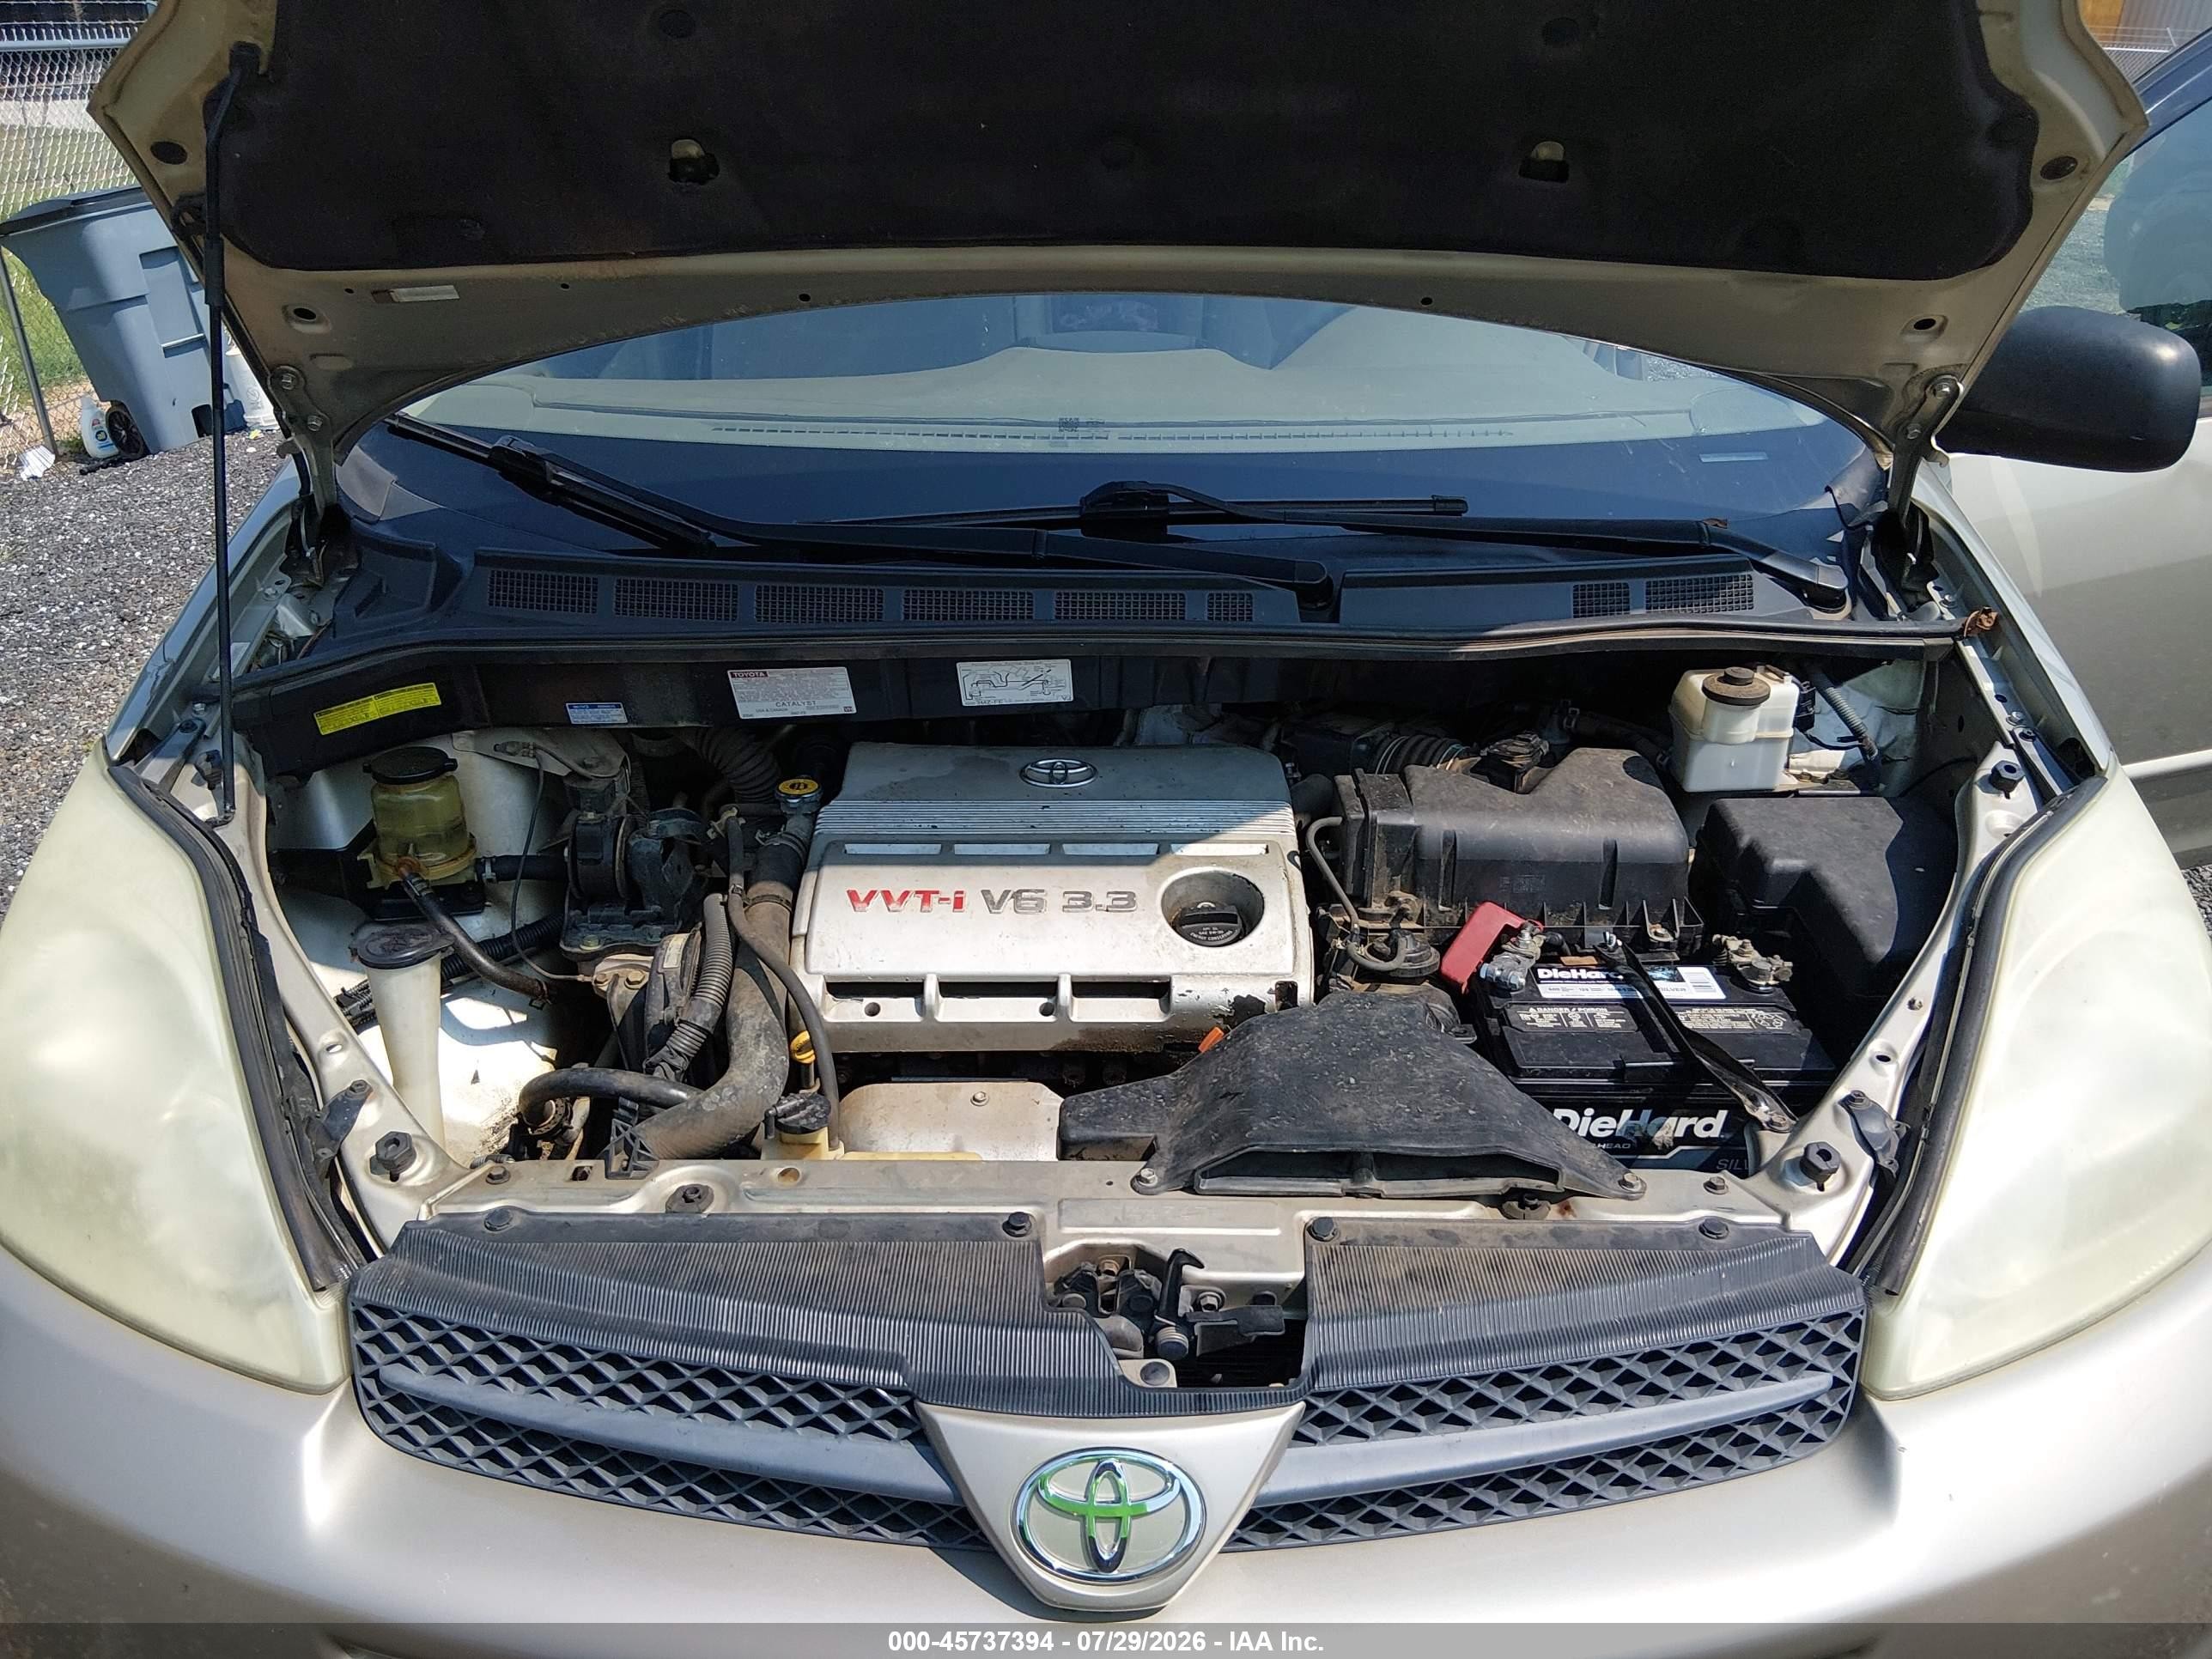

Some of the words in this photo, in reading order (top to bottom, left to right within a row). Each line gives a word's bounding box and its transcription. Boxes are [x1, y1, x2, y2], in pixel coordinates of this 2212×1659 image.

[846, 889, 966, 914] VVT-i
[981, 889, 1048, 915] V6
[1062, 890, 1138, 913] 3.3
[1553, 1108, 1729, 1138] DieHard
